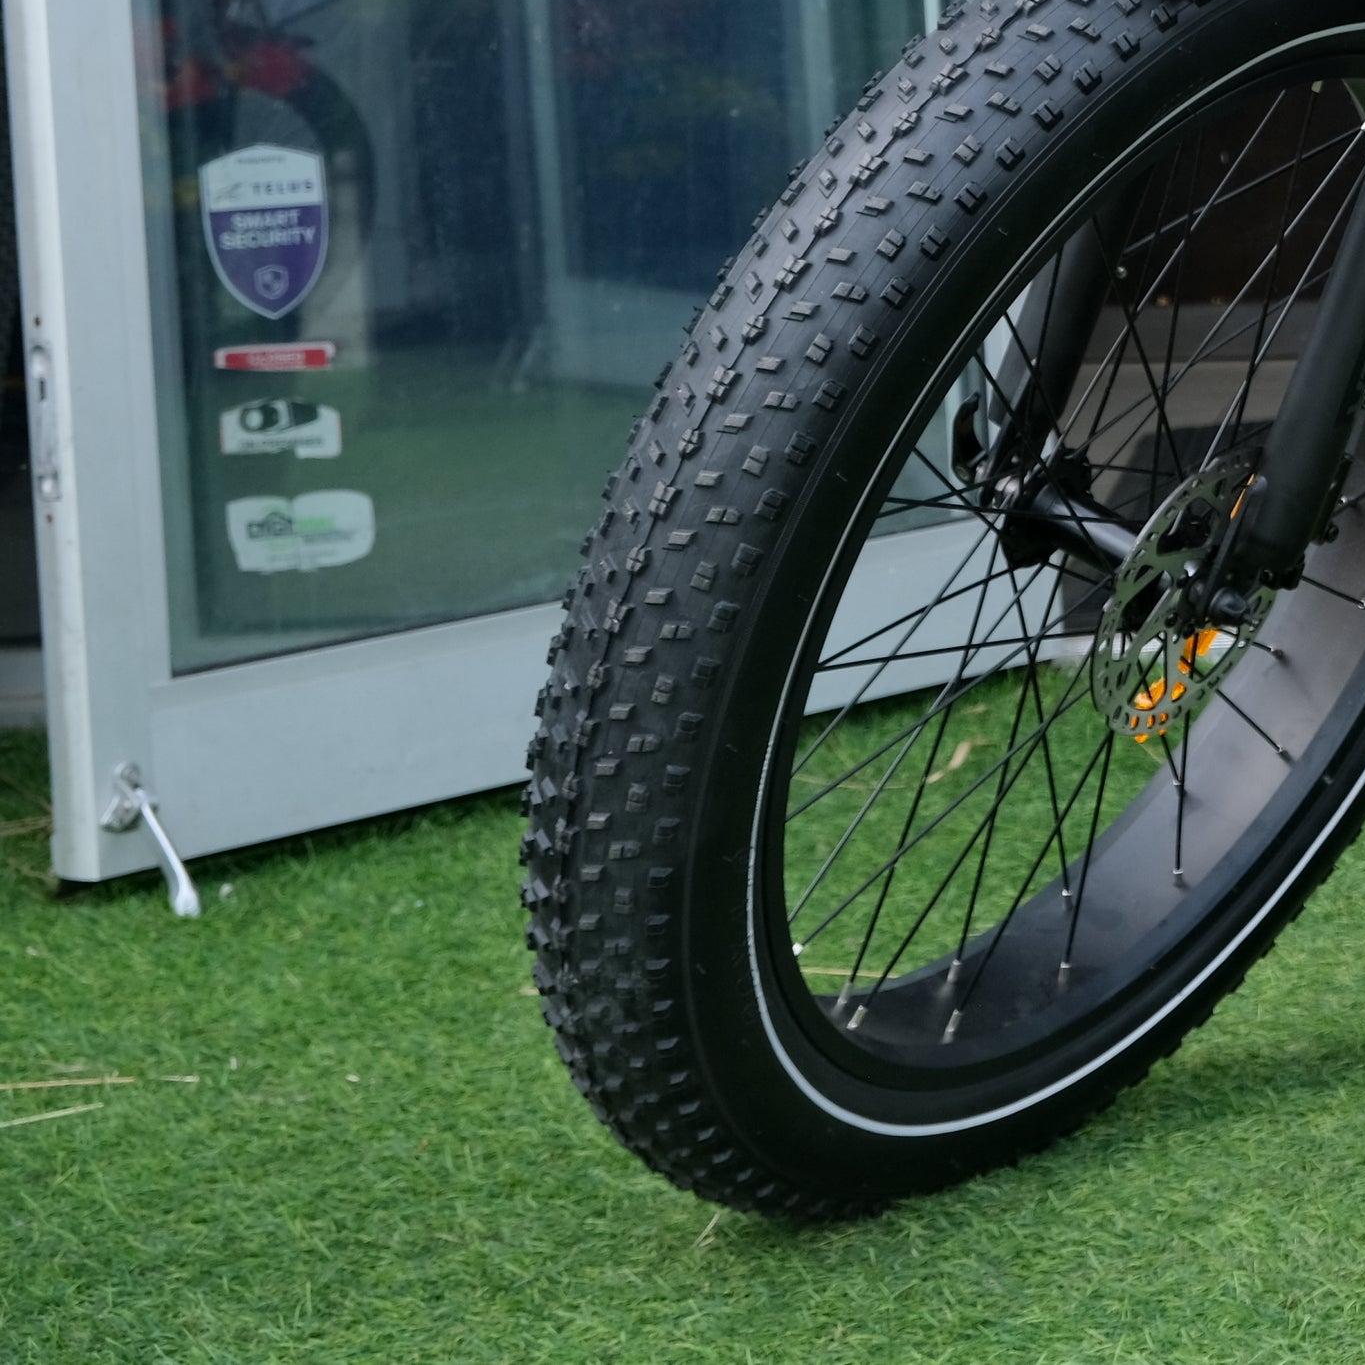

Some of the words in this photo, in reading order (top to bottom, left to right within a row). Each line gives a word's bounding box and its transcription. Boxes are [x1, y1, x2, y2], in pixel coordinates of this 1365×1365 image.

[252, 180, 313, 196] TELUS
[231, 208, 301, 230] SMART
[219, 226, 316, 250] SECURITY
